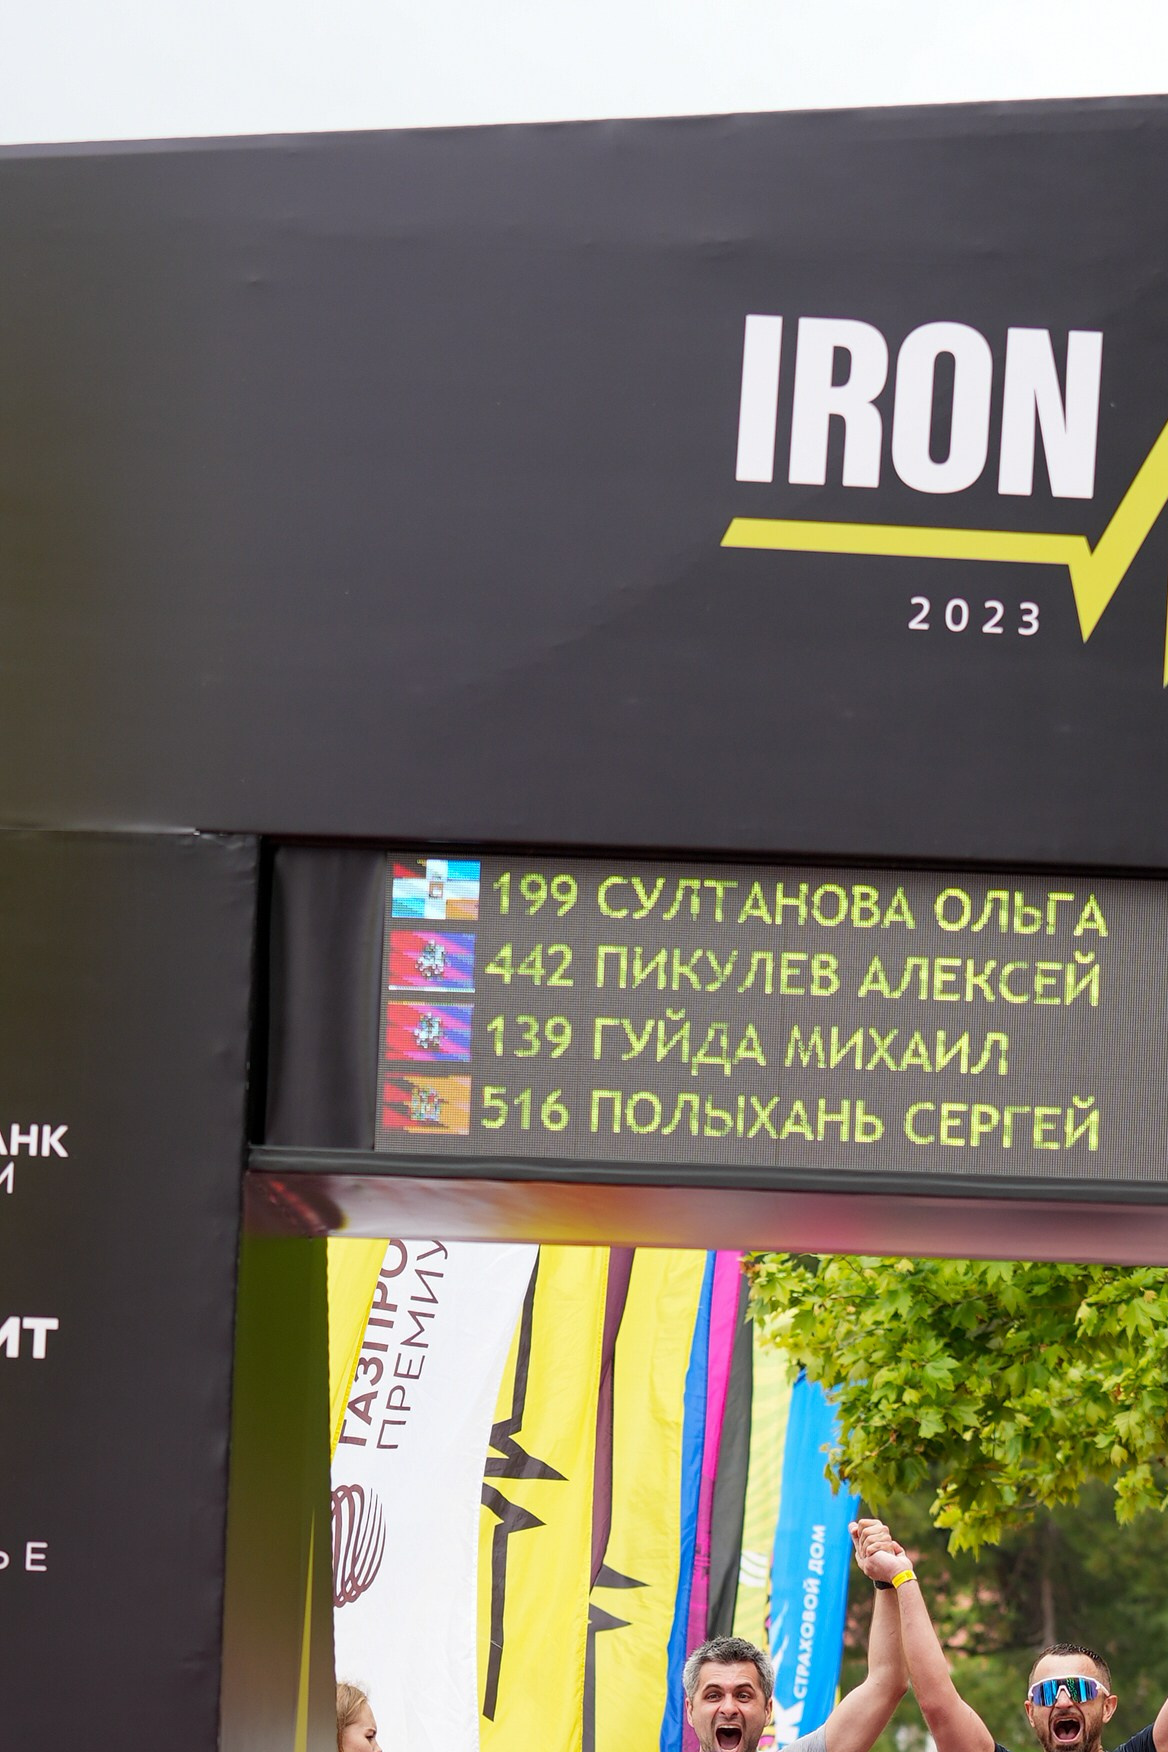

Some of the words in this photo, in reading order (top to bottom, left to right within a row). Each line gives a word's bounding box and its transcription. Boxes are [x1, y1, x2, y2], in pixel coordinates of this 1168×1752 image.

[735, 314, 1104, 500] IRON
[907, 596, 1041, 637] 2023
[493, 872, 578, 917] 199
[597, 875, 916, 930] СУЛТАНОВА
[934, 887, 1108, 939] ОЛЬГА
[485, 944, 575, 988] 442
[596, 946, 840, 998] ПИКУЛЕВ
[858, 950, 1100, 1007] АЛЕКСЕЙ
[486, 1014, 573, 1058] 139
[592, 1009, 767, 1077] ГУЙДА
[784, 1025, 1009, 1076] МИХАИЛ
[481, 1086, 569, 1131] 516
[590, 1089, 885, 1145] ПОЛЫХАНЬ
[904, 1095, 1100, 1152] СЕРГЕЙ
[793, 1577, 821, 1700] СТРАХОВОЙ
[808, 1524, 827, 1576] ДОМ
